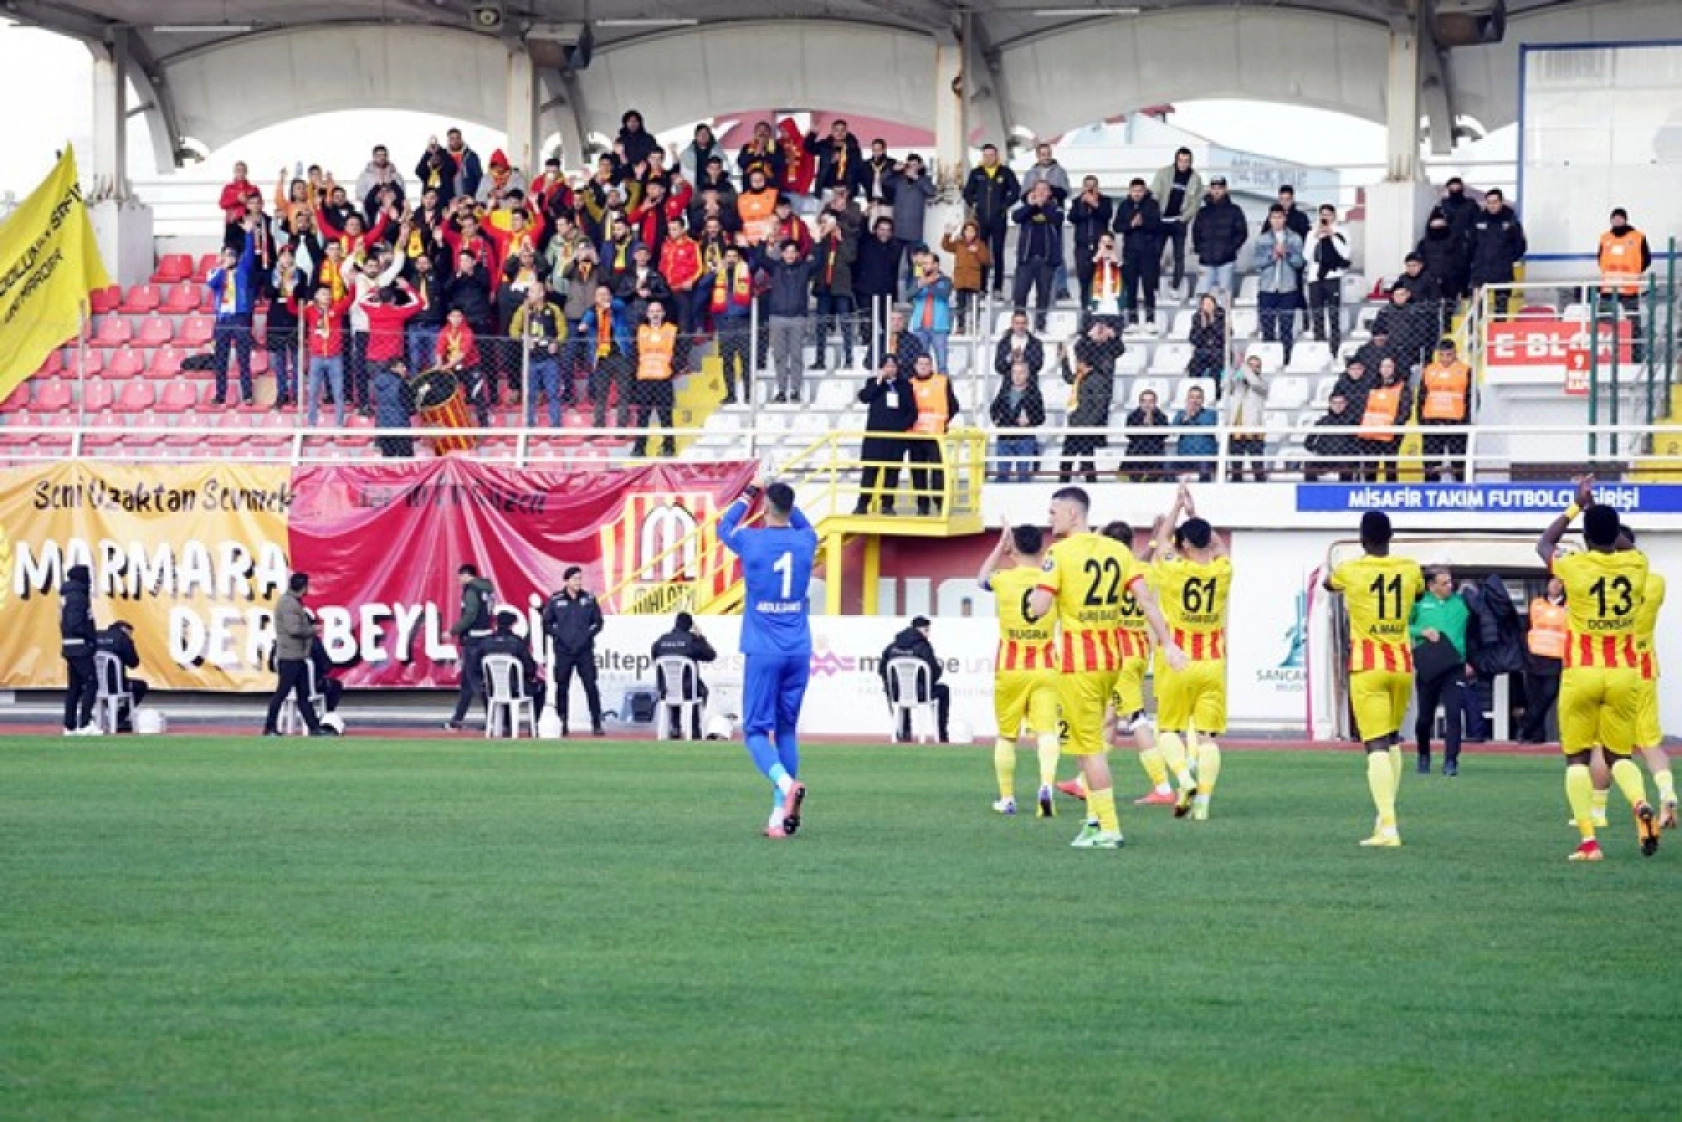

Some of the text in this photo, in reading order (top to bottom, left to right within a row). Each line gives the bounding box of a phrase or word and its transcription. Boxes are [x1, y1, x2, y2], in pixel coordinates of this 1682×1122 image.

[1493, 333, 1516, 358] E
[34, 476, 83, 510] Seni
[87, 478, 196, 513] Uzaktan
[1349, 486, 1422, 508] MİSAFİR
[1426, 490, 1484, 508] TAKIM
[773, 551, 792, 599] 1
[1083, 557, 1121, 606] 22
[1181, 576, 1216, 612] 61
[1370, 573, 1402, 620] 11
[1589, 574, 1632, 618] 13
[594, 648, 650, 681] altep
